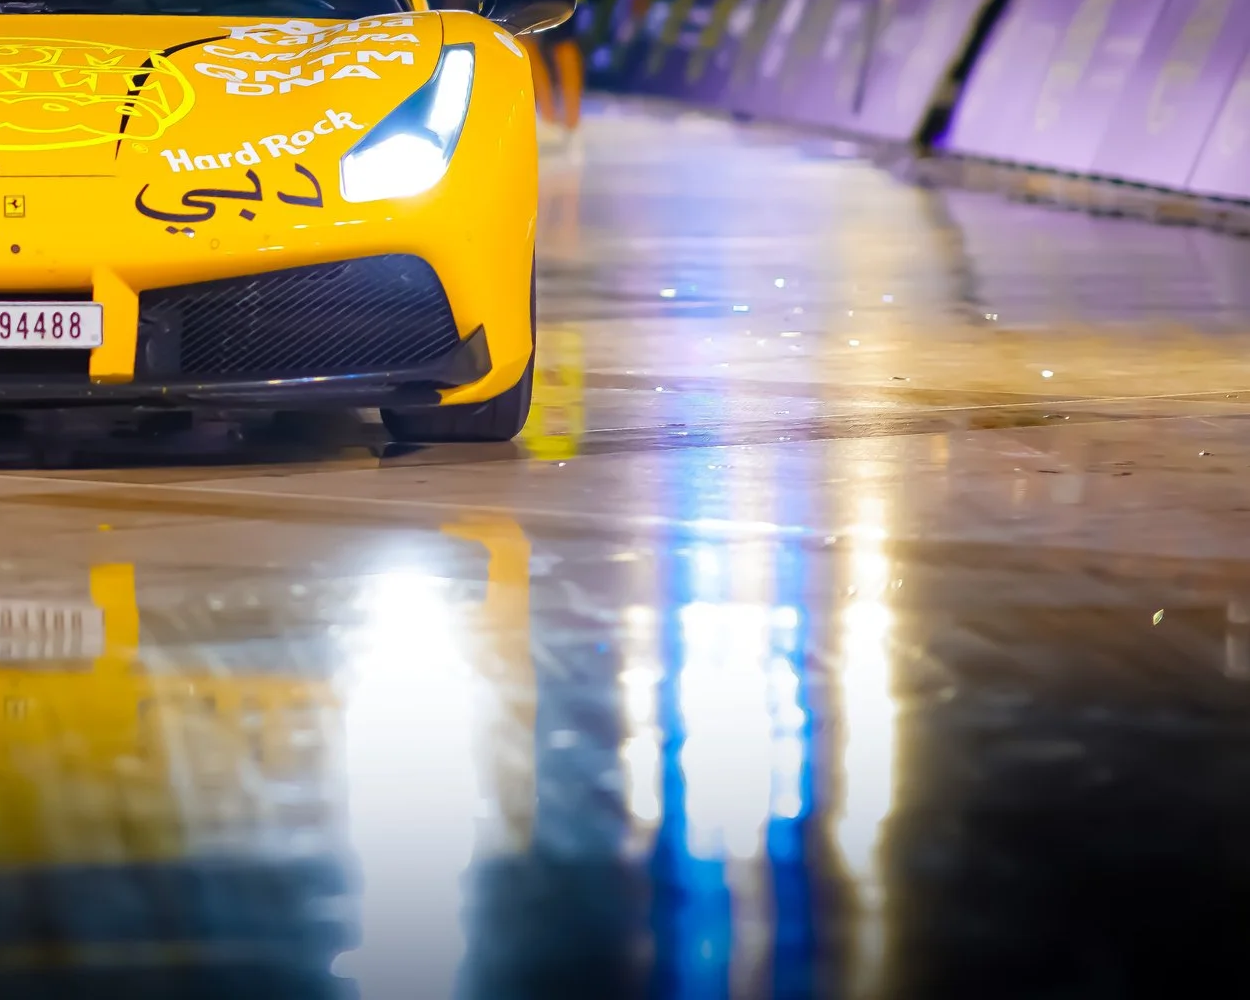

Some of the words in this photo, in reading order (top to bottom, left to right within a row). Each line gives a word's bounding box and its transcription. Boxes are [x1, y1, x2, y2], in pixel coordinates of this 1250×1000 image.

[193, 50, 414, 83] QNTM
[225, 64, 382, 96] DNA
[160, 142, 262, 173] Hard
[258, 108, 365, 158] Rock
[134, 162, 324, 239] دبي
[0, 311, 81, 340] 94488
